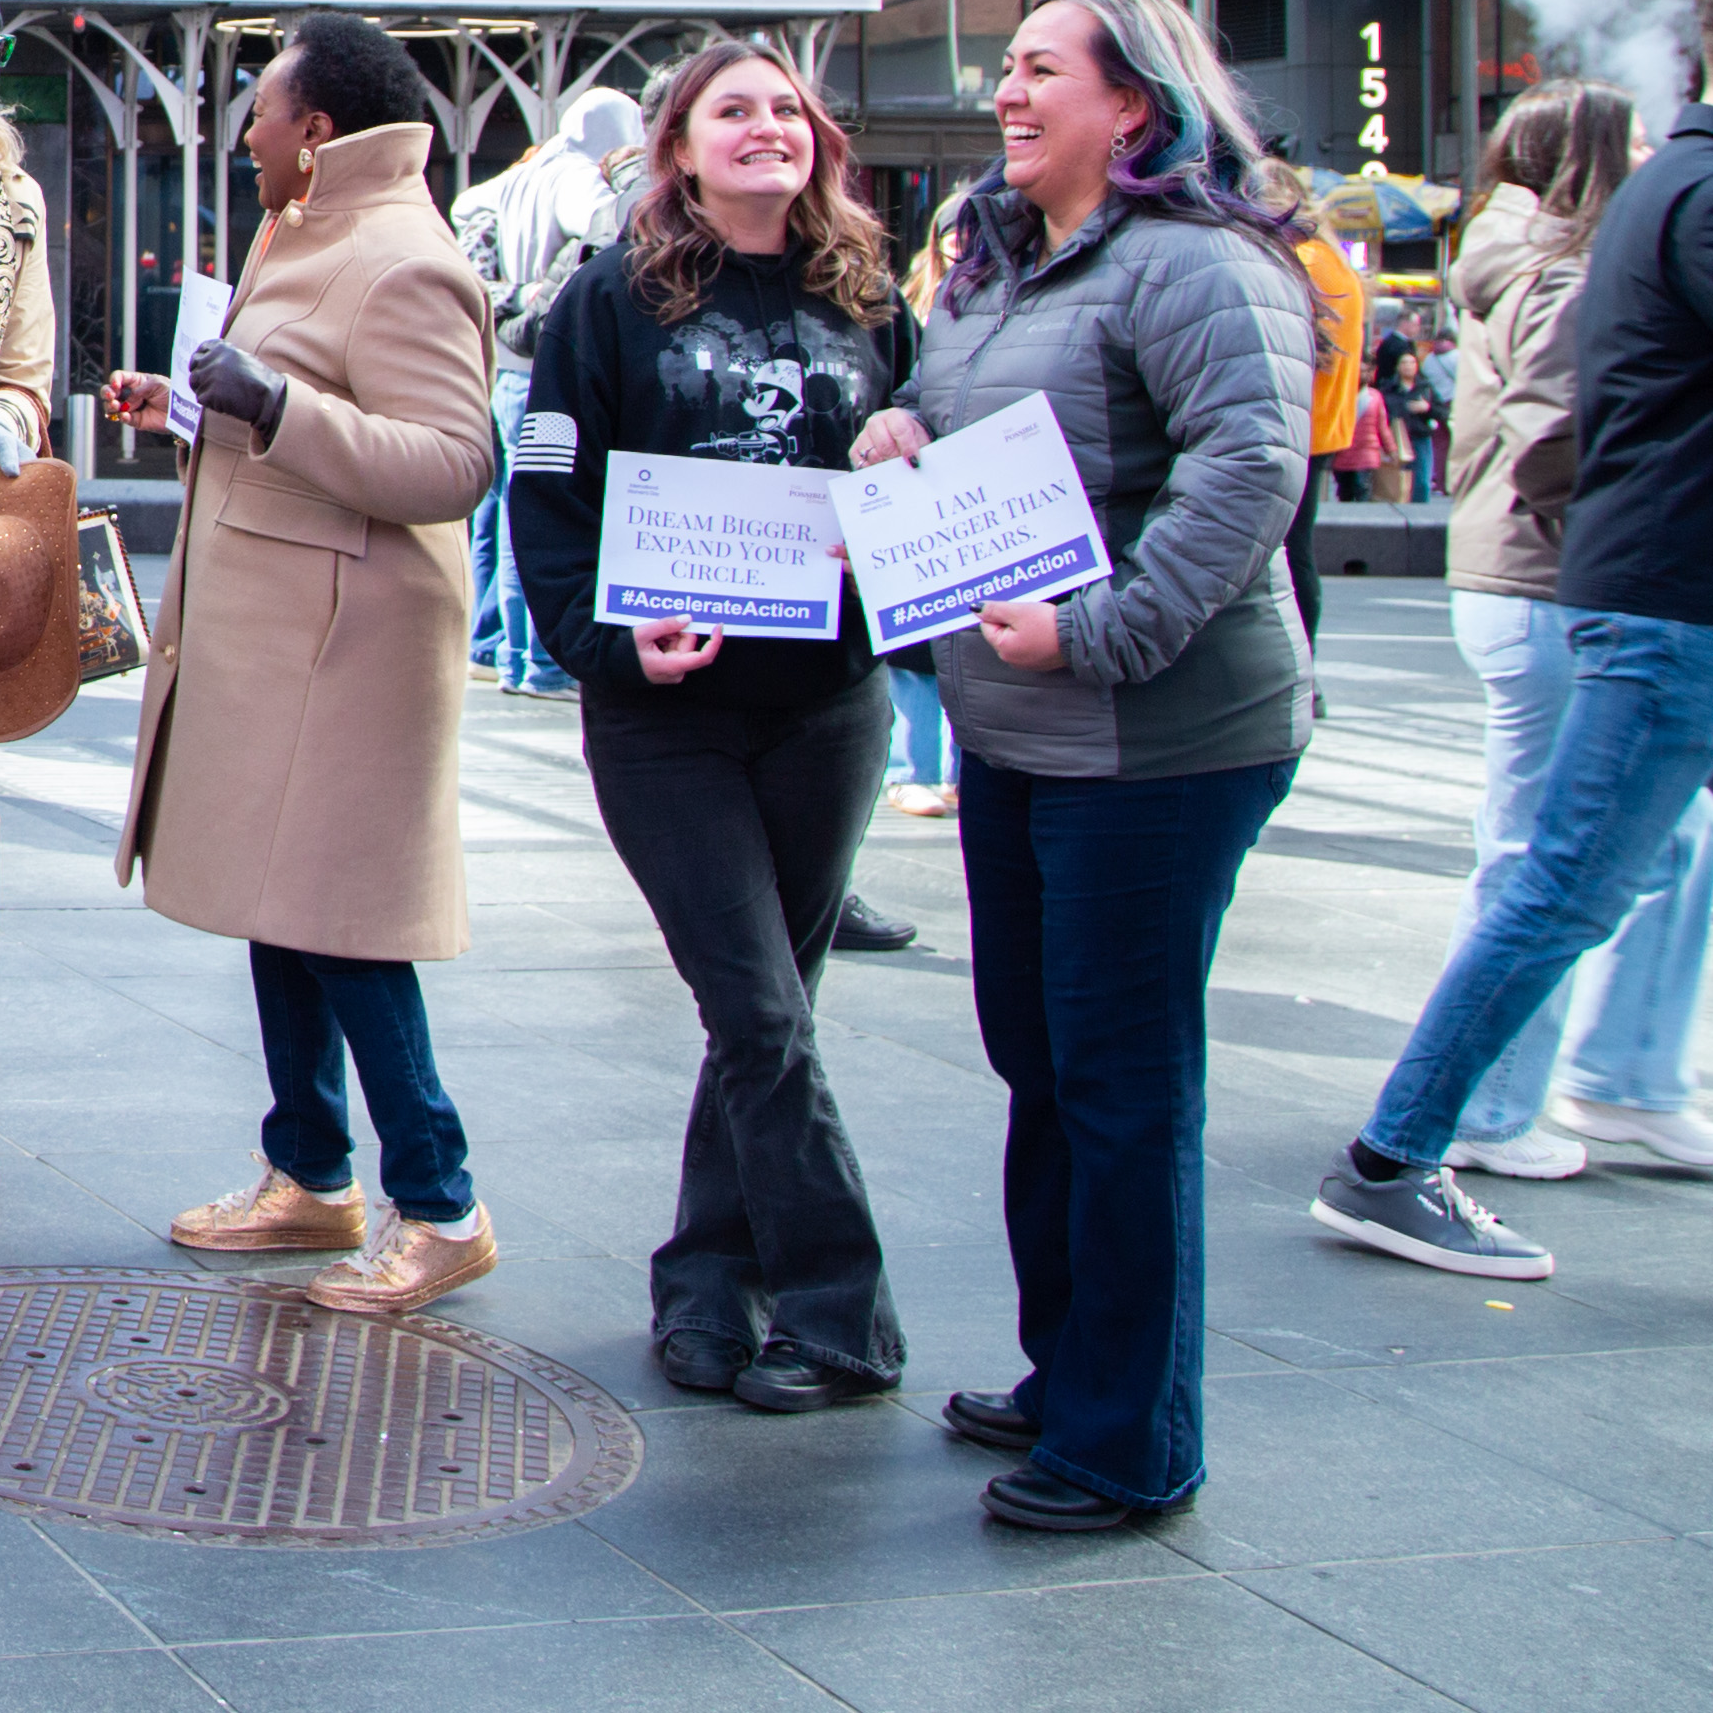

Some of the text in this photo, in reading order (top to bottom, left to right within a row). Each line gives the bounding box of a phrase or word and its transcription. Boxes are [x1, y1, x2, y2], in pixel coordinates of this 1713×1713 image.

[935, 486, 987, 520] I AM
[627, 505, 818, 543] DREAM BIGGER.
[871, 479, 1068, 570] STRONGER THAN
[636, 531, 806, 566] EXPAND YOUR
[915, 524, 1037, 583] MY FEARS.
[670, 560, 766, 586] CIRCLE.
[892, 547, 1078, 626] #AccelerateAction
[620, 589, 811, 620] #AccelerateAction
